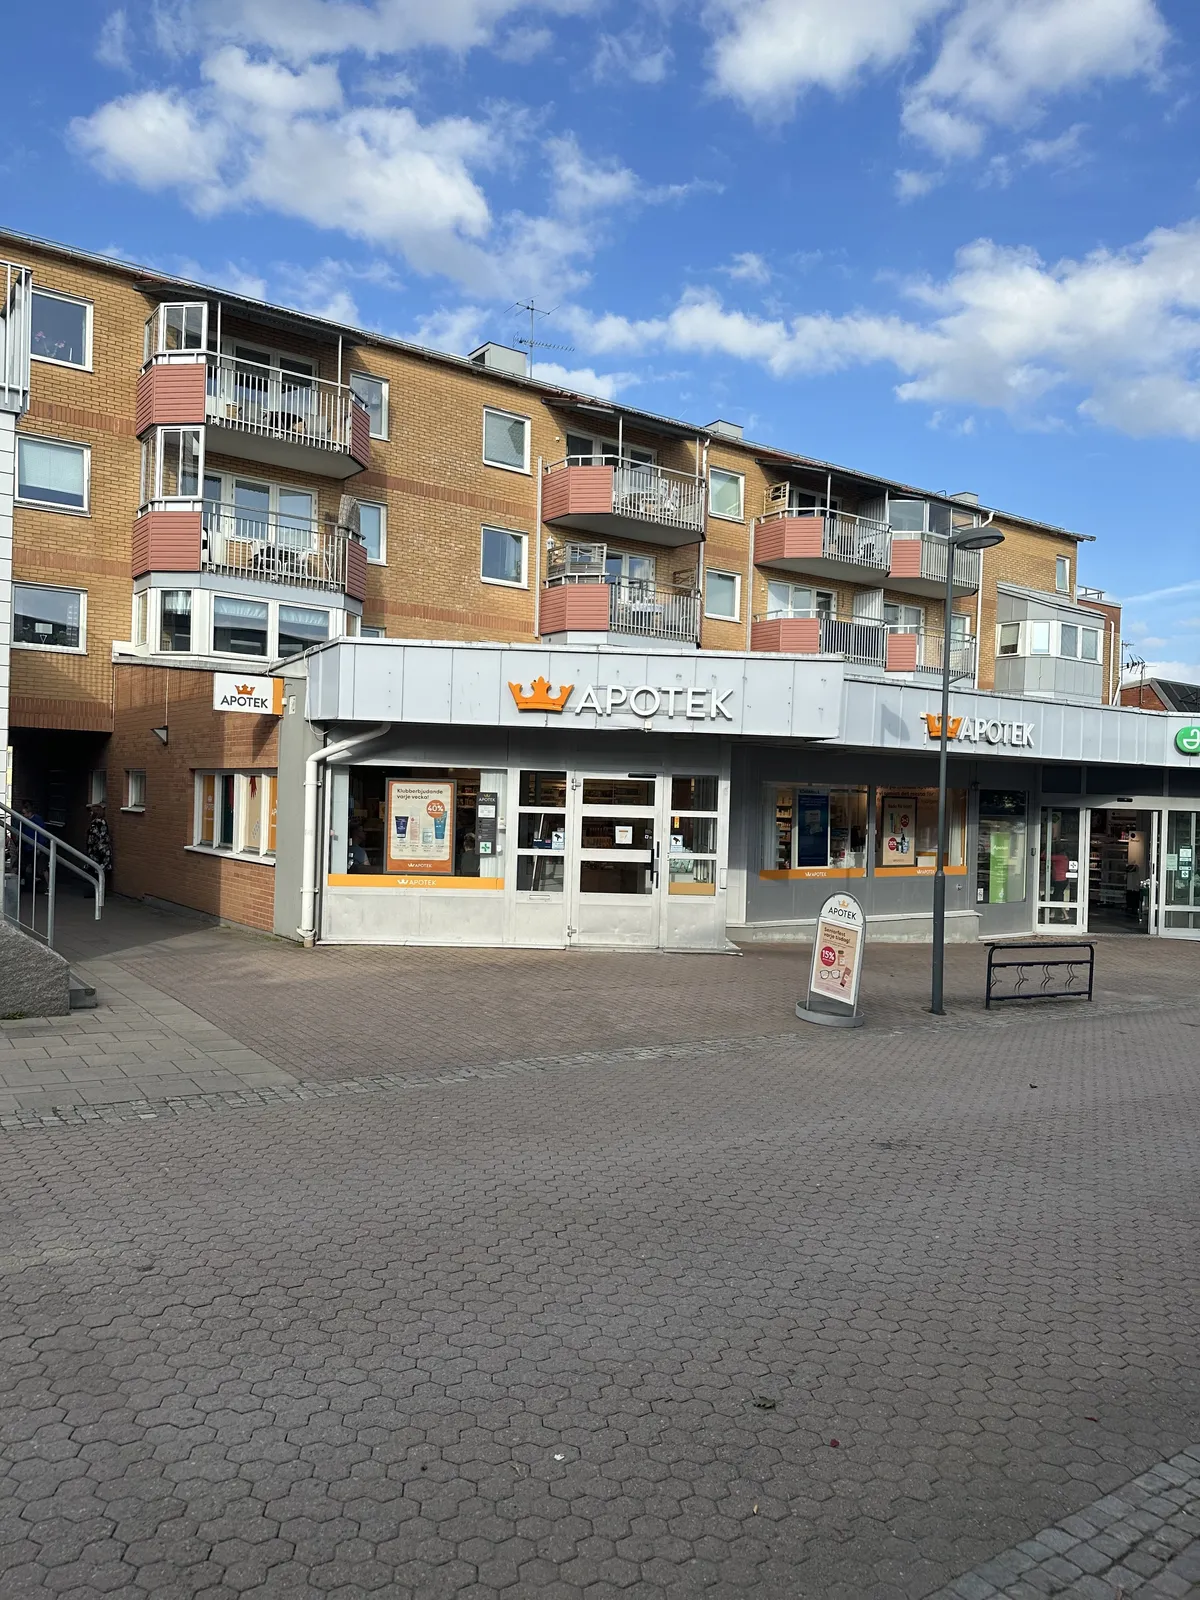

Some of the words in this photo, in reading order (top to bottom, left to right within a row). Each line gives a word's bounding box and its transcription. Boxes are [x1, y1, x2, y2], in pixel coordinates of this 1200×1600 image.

[220, 695, 268, 709] APOTEK
[575, 684, 734, 722] APOTEK
[958, 716, 1036, 747] APOTEK
[427, 804, 444, 812] 40%
[828, 907, 857, 920] APOTEK
[824, 927, 846, 937] Seniorfest
[823, 950, 835, 960] 15%
